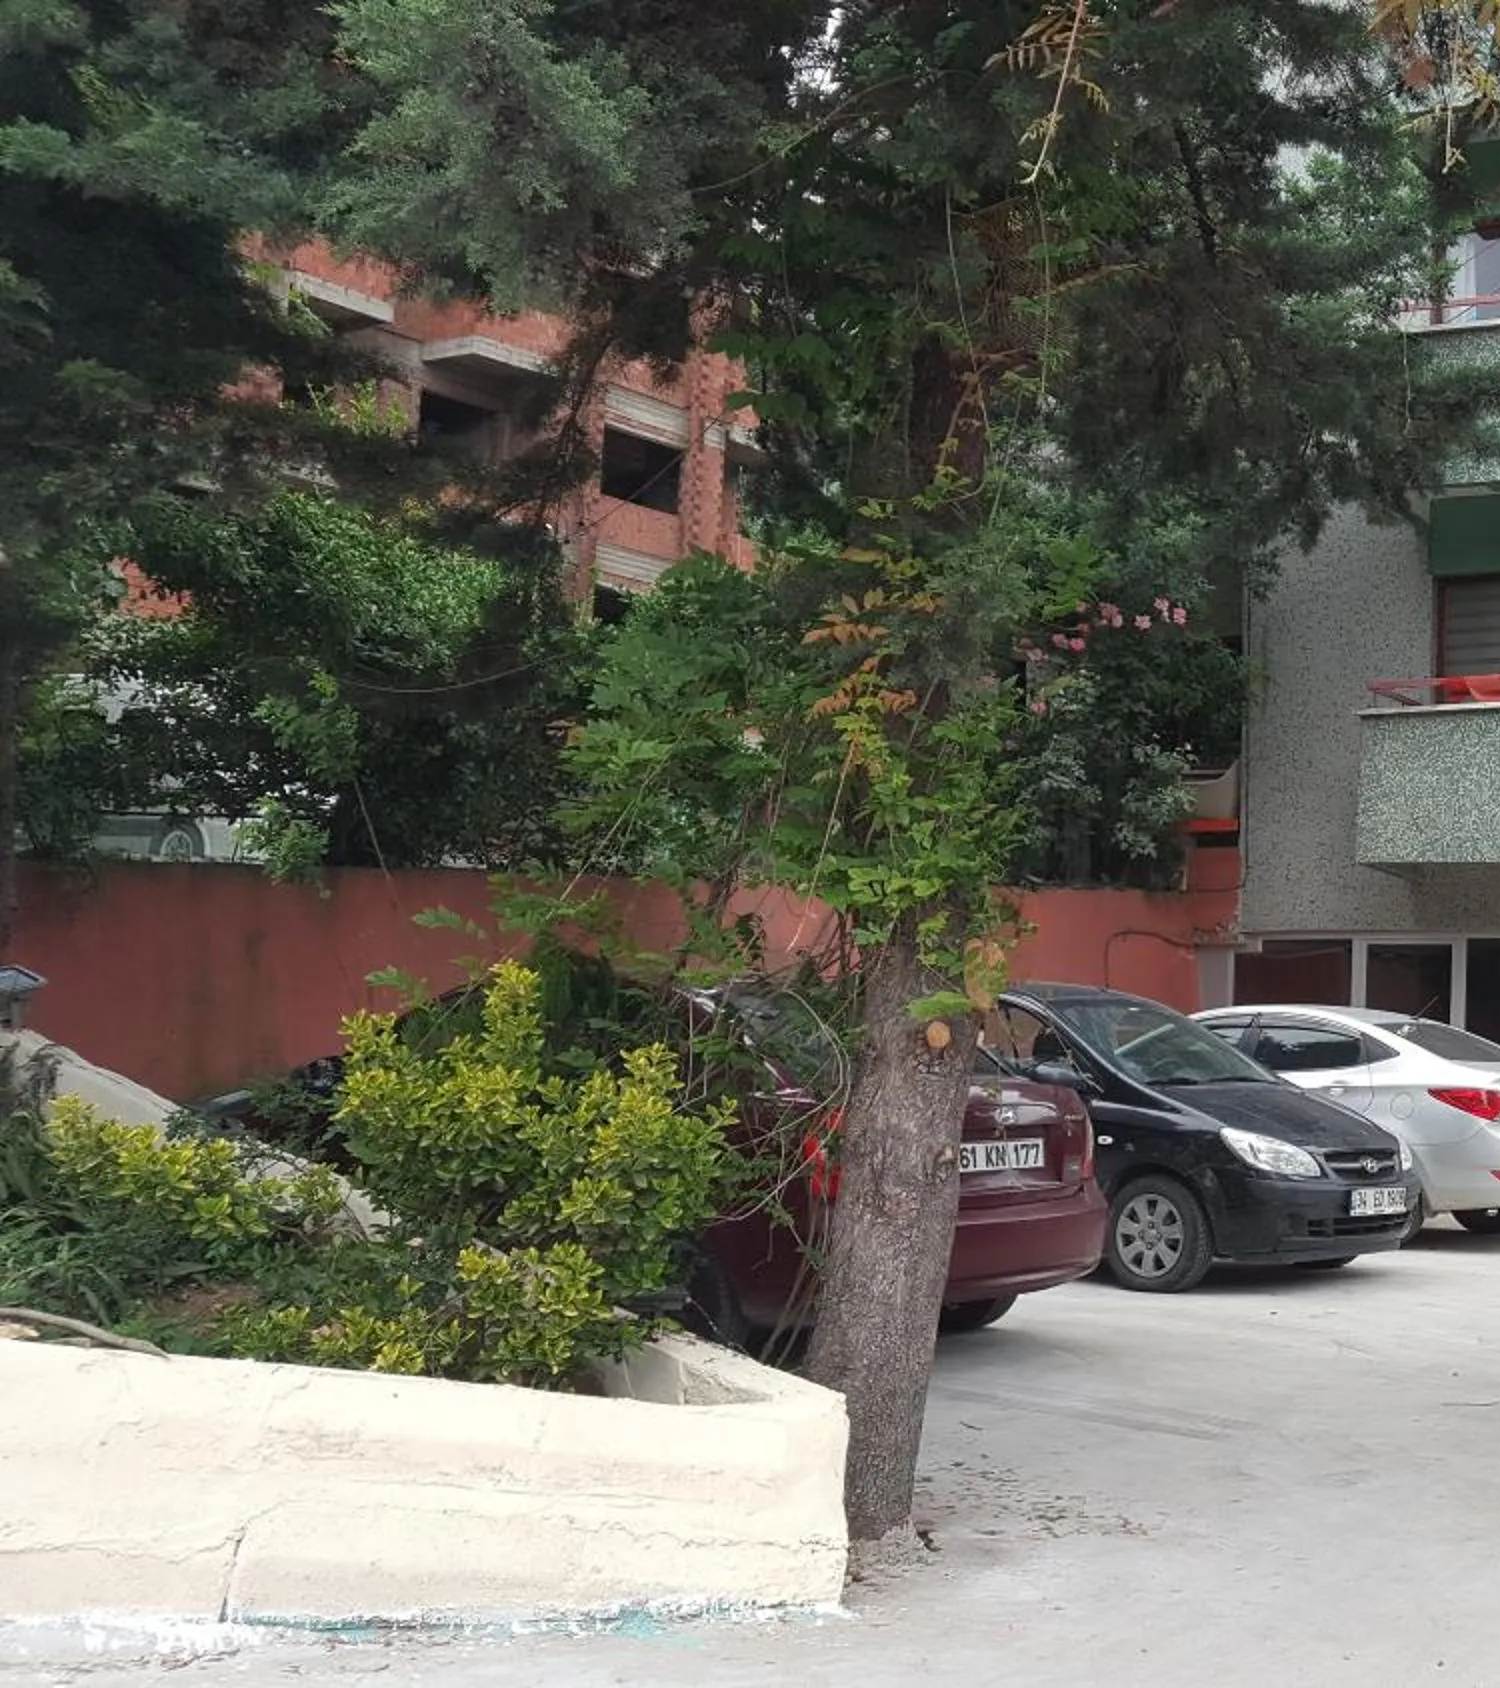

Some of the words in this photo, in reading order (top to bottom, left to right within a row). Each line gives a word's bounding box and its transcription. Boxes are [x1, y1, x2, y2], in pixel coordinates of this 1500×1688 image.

[960, 1146, 977, 1169] 61
[985, 1144, 1006, 1168] KN
[1013, 1143, 1040, 1166] 177
